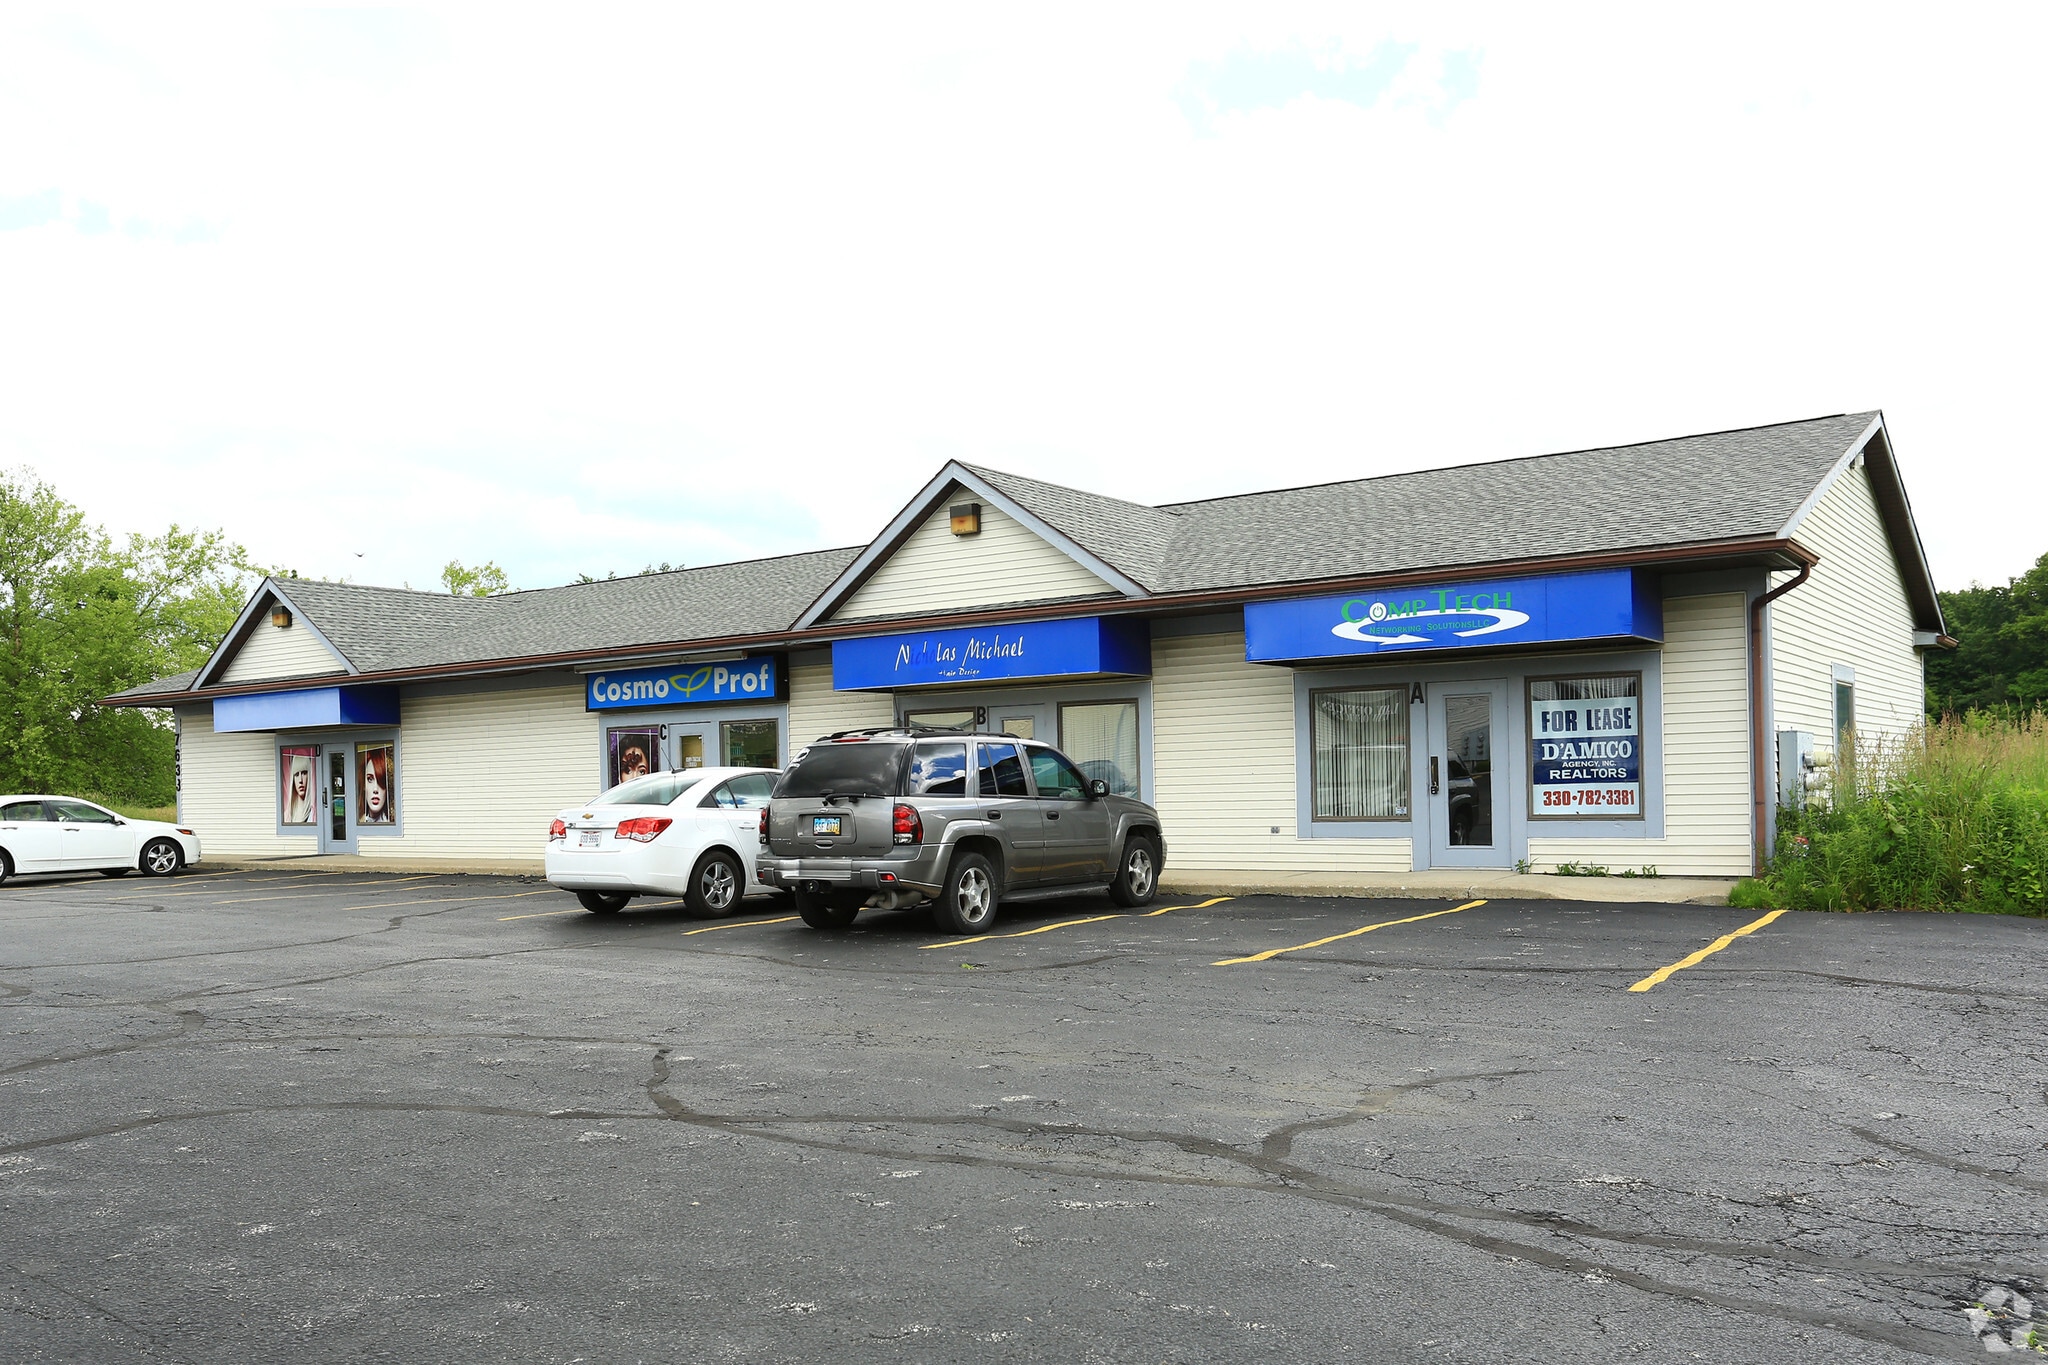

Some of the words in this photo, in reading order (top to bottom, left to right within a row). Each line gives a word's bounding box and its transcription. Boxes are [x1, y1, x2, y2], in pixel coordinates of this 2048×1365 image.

[1341, 599, 1427, 623] COMP
[1430, 589, 1512, 613] TECH
[1369, 625, 1421, 635] NETWORKING
[962, 635, 1024, 666] Michael
[592, 676, 669, 702] Cosmo
[714, 664, 768, 694] Prof
[1410, 682, 1424, 704] A
[976, 706, 986, 725] B
[1541, 710, 1578, 732] FOR
[1586, 707, 1632, 731] LEASE
[660, 724, 667, 740] C
[1541, 740, 1632, 761] D'AMICO
[1549, 768, 1627, 780] REALTORS
